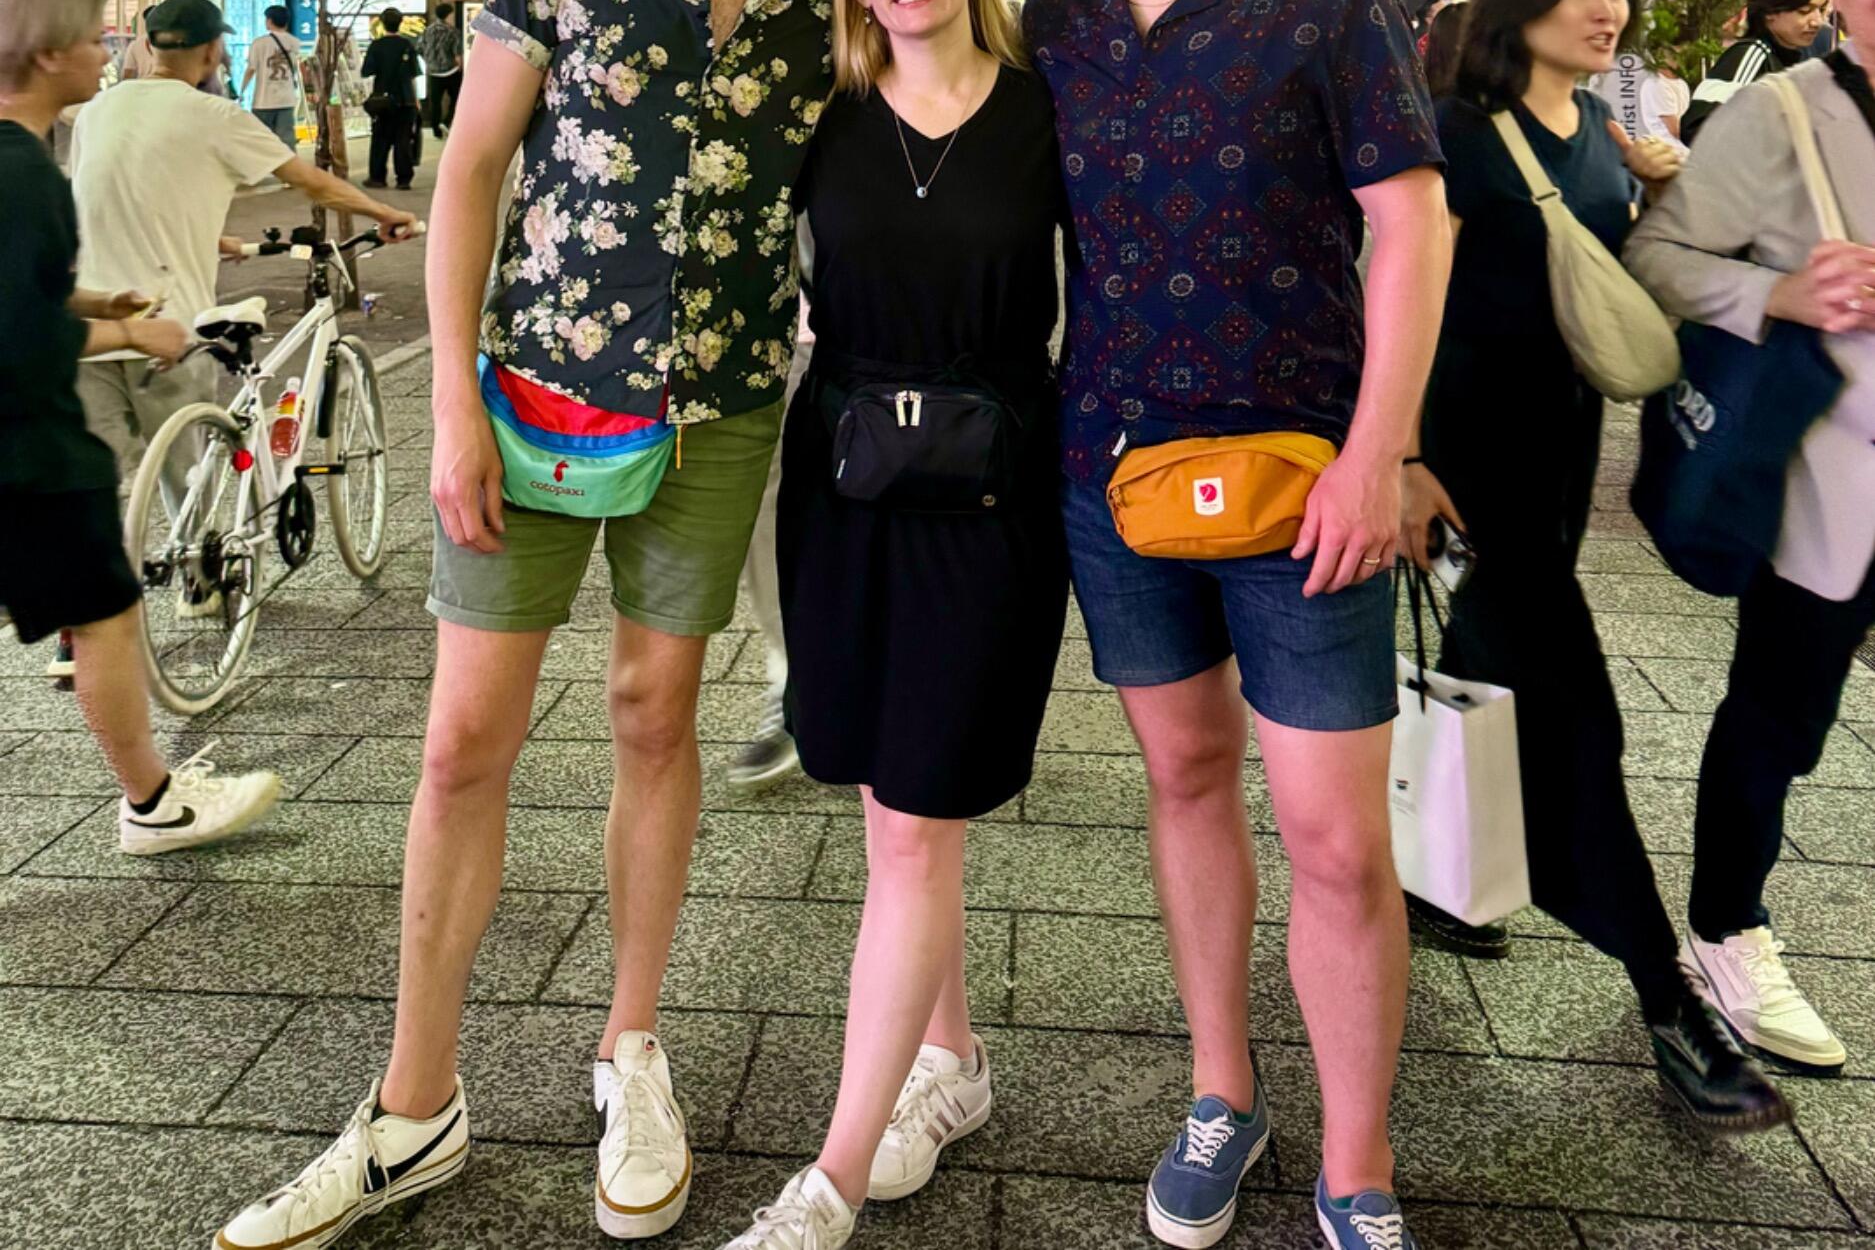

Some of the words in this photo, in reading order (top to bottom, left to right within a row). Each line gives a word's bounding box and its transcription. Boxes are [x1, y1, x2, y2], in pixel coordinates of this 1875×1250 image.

[301, 22, 311, 35] 2
[1619, 55, 1636, 99] INFO
[530, 480, 585, 496] cotopaxi
